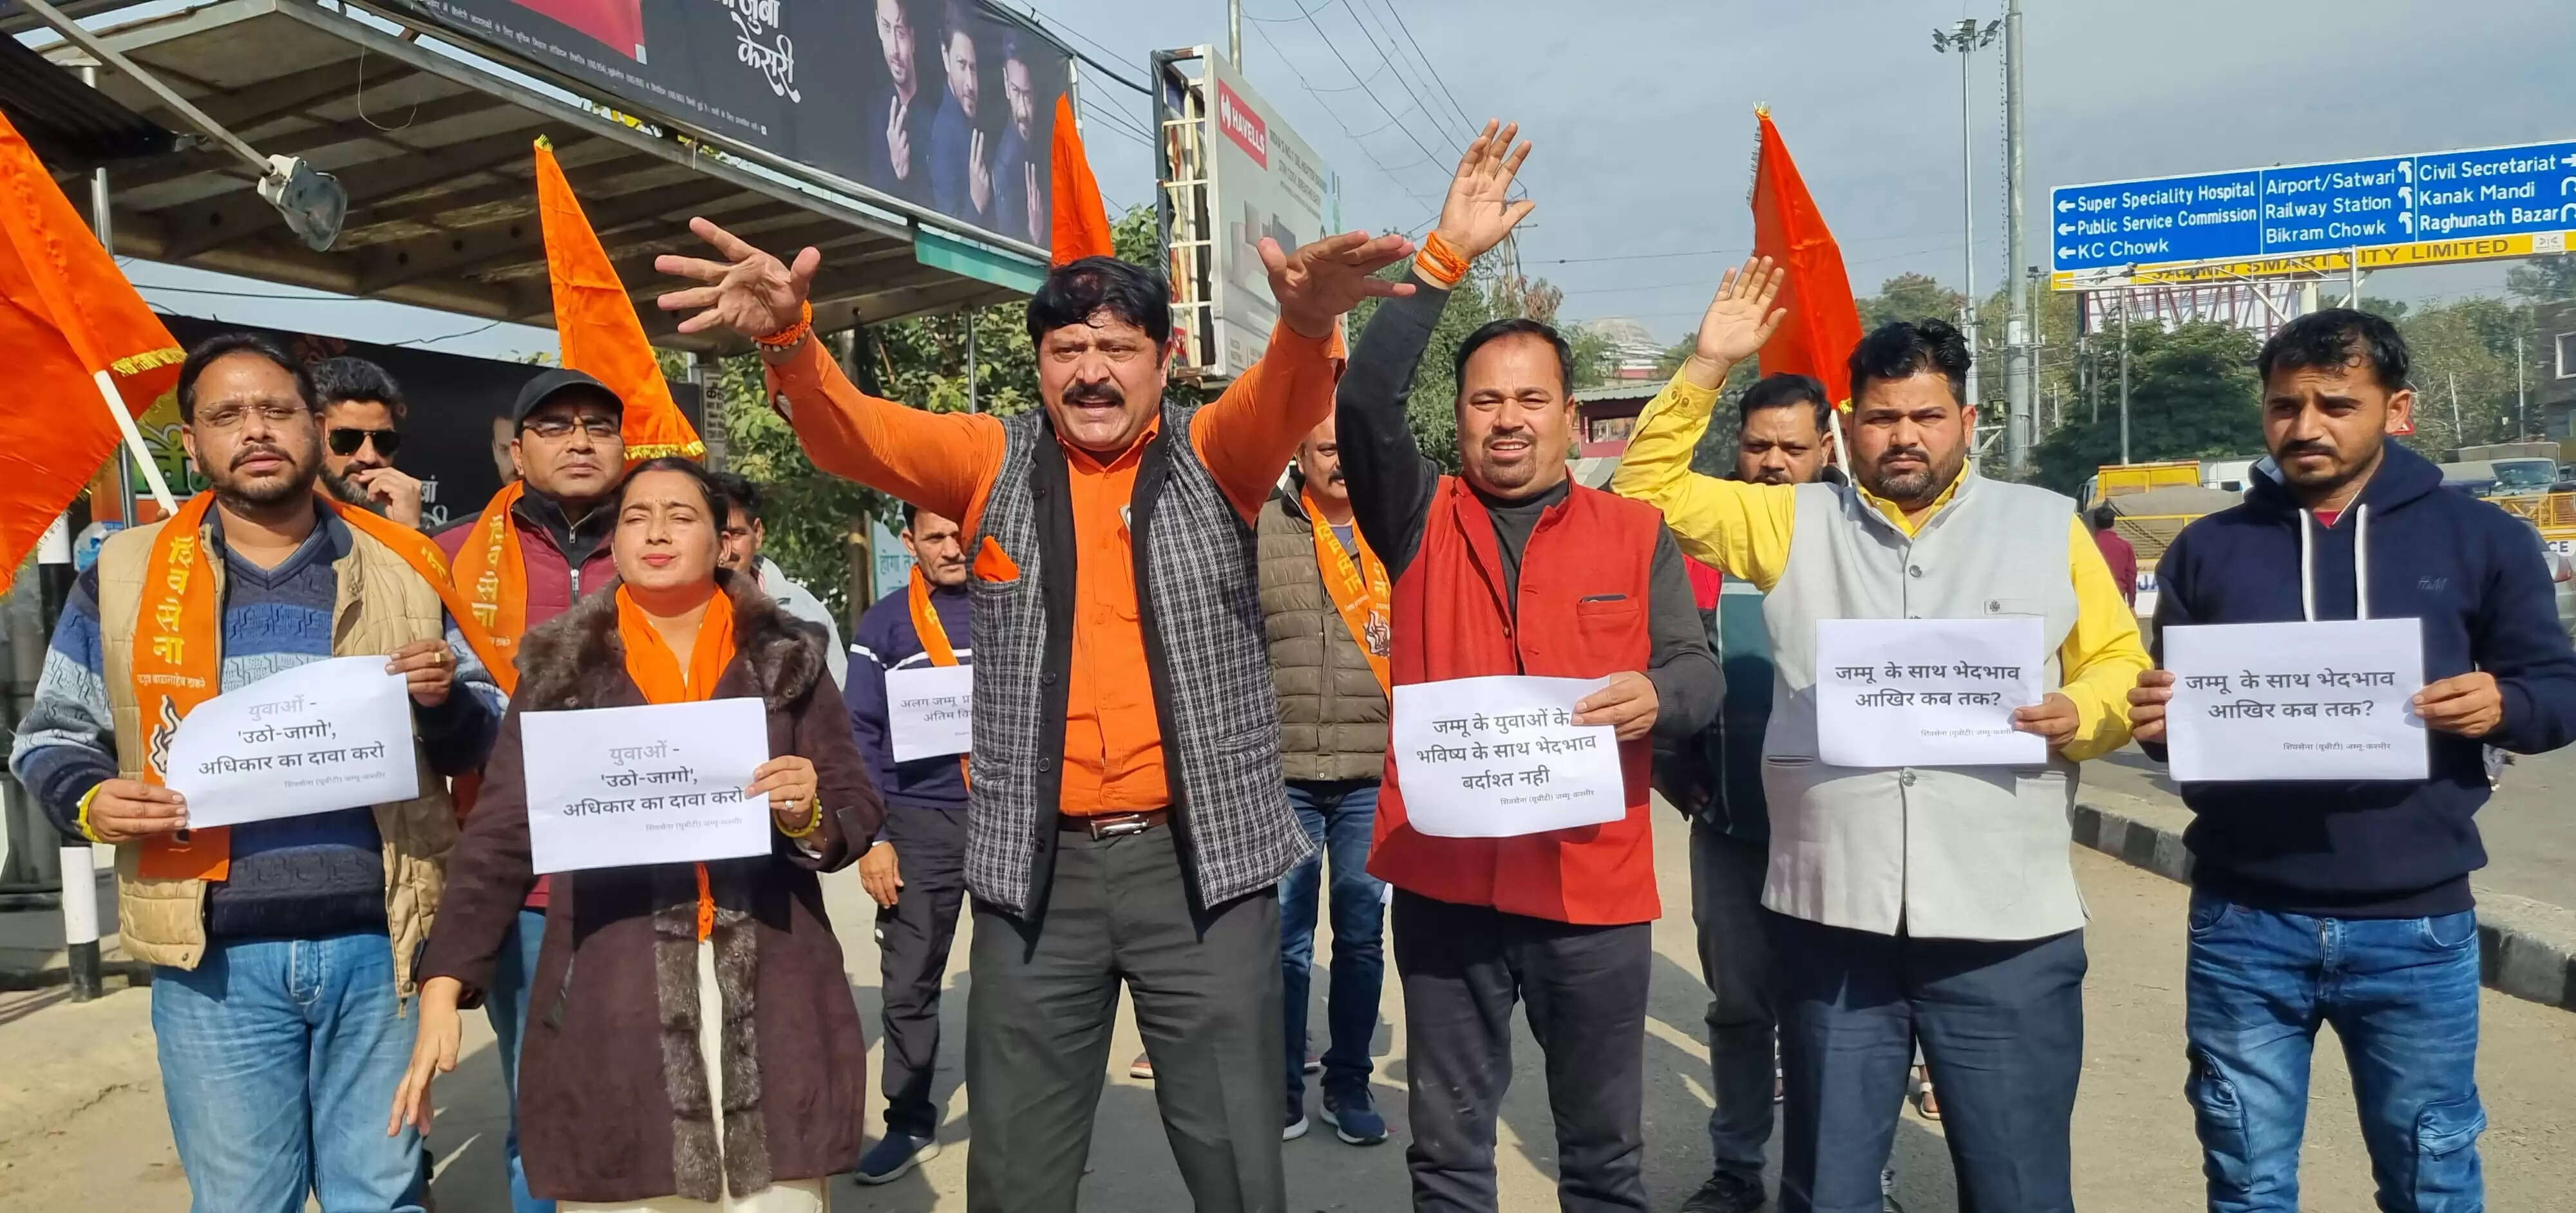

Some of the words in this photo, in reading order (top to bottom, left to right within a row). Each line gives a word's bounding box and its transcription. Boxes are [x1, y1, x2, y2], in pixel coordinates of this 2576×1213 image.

[730, 11, 801, 103] केसरी
[1232, 107, 1264, 155] HAVELLS
[2420, 162, 2456, 181] Civil
[2461, 154, 2556, 178] Secretariat
[2266, 169, 2395, 196] Airport/Satwari
[2420, 187, 2474, 206] Kanak
[2480, 181, 2535, 201] Mandi
[2078, 196, 2117, 213] Super
[2122, 187, 2193, 210] Speciality
[2198, 181, 2255, 202] Hospital
[2266, 202, 2327, 219] Railway
[2333, 196, 2391, 213] Station
[2078, 218, 2118, 236] Public
[2123, 214, 2173, 232] Service
[2177, 208, 2257, 227] Commission
[2266, 227, 2324, 243] Bikram
[2328, 220, 2386, 238] Chowk
[2420, 209, 2505, 233] Raghunath
[2512, 207, 2559, 223] Bazar
[2078, 243, 2105, 259] KC
[2110, 238, 2170, 256] Chowk
[2411, 239, 2509, 259] LIMITED
[153, 535, 194, 664] शिवसेना
[1835, 666, 1877, 684] जम्मू
[1884, 661, 1902, 679] के
[1908, 664, 1949, 679] साथ
[1953, 661, 2021, 680] भेदभाव
[2185, 674, 2231, 695] जम्मू
[2240, 670, 2260, 689] के
[2266, 673, 2310, 689] साथ
[2316, 667, 2395, 688] भेदभाव
[249, 694, 305, 720] युवाओं
[900, 698, 929, 708] अलग
[932, 696, 958, 707] जम्मू
[1855, 688, 1915, 708] आखिर
[1920, 692, 1952, 706] कब
[1957, 691, 2001, 706] तक?
[2208, 699, 2275, 719] आखिर
[2282, 702, 2318, 718] कब
[2324, 699, 2374, 718] तक?
[1432, 719, 1470, 738] जम्मू
[1472, 713, 1489, 733] के
[1493, 708, 1549, 734] युवाओं
[1553, 708, 1570, 727] के
[198, 755, 273, 775] अधिकार
[278, 754, 302, 768] का
[308, 749, 346, 766] दावा
[351, 741, 385, 762] करो
[609, 740, 667, 765] युवाओं
[1417, 745, 1466, 764] भविष्य
[1472, 741, 1488, 760] के
[1493, 742, 1530, 759] साथ
[1535, 734, 1596, 756] भेदभाव
[1462, 769, 1514, 790] बर्दाश्त
[1519, 764, 1550, 787] नही
[563, 798, 635, 818] अधिकार
[640, 796, 664, 811] का
[668, 793, 705, 809] दावा
[711, 786, 744, 805] करो
